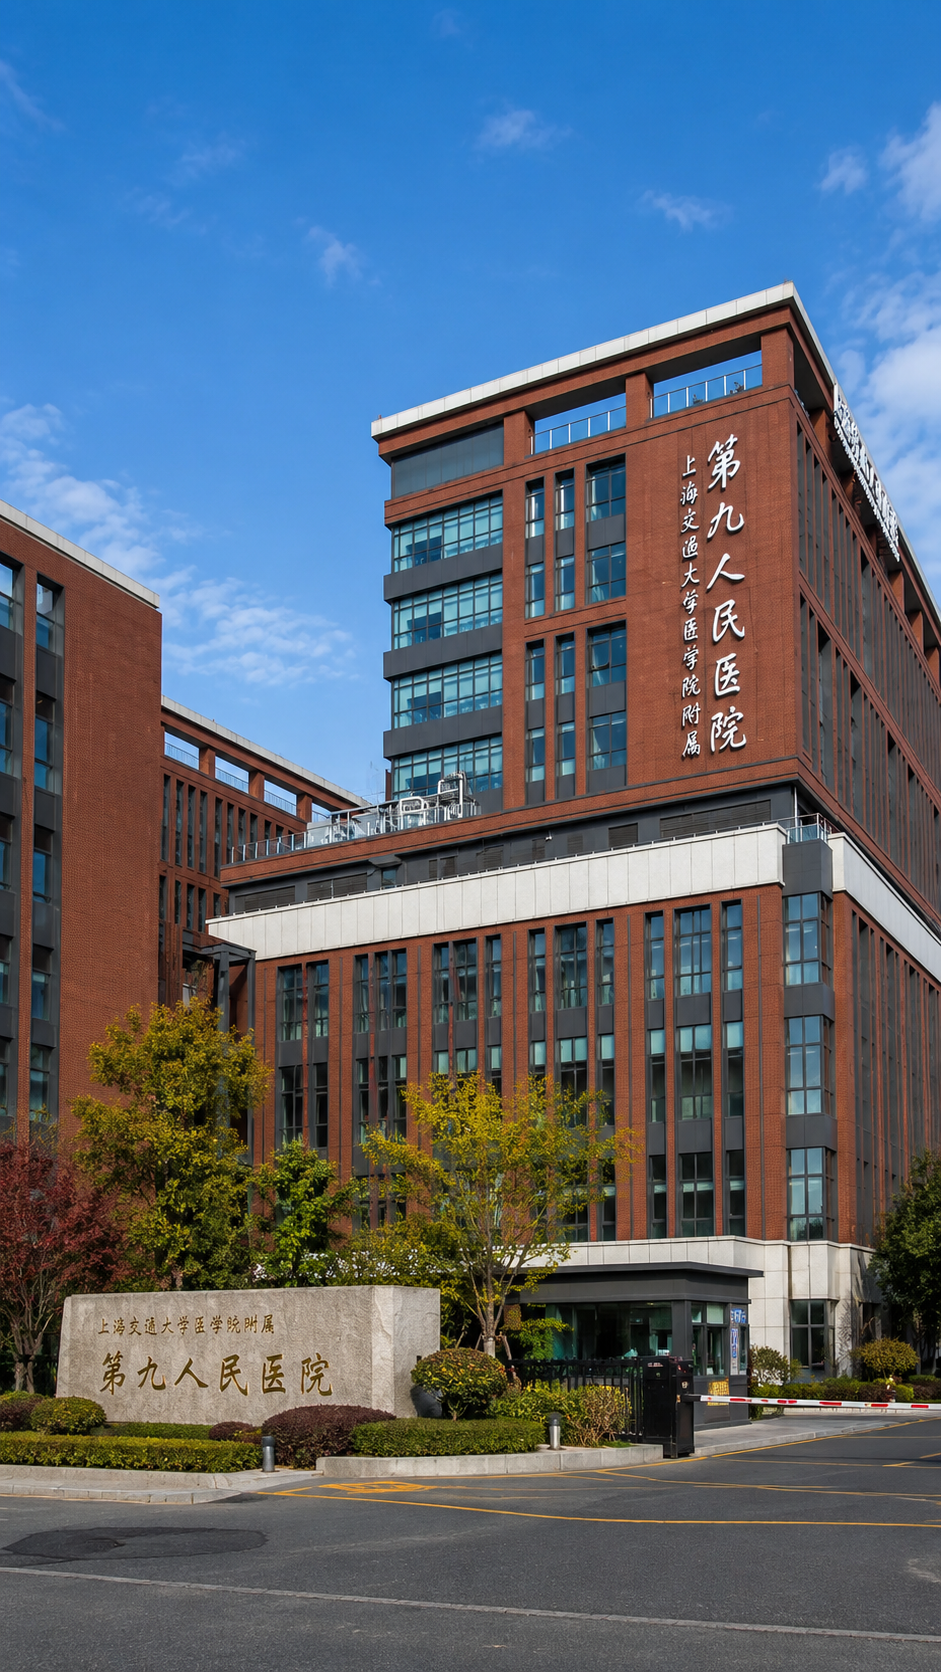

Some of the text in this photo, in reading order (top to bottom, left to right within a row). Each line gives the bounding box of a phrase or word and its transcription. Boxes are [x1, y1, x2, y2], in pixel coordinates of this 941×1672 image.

[707, 433, 746, 753] 第九人民医院
[99, 1350, 333, 1397] 第九人民医院
